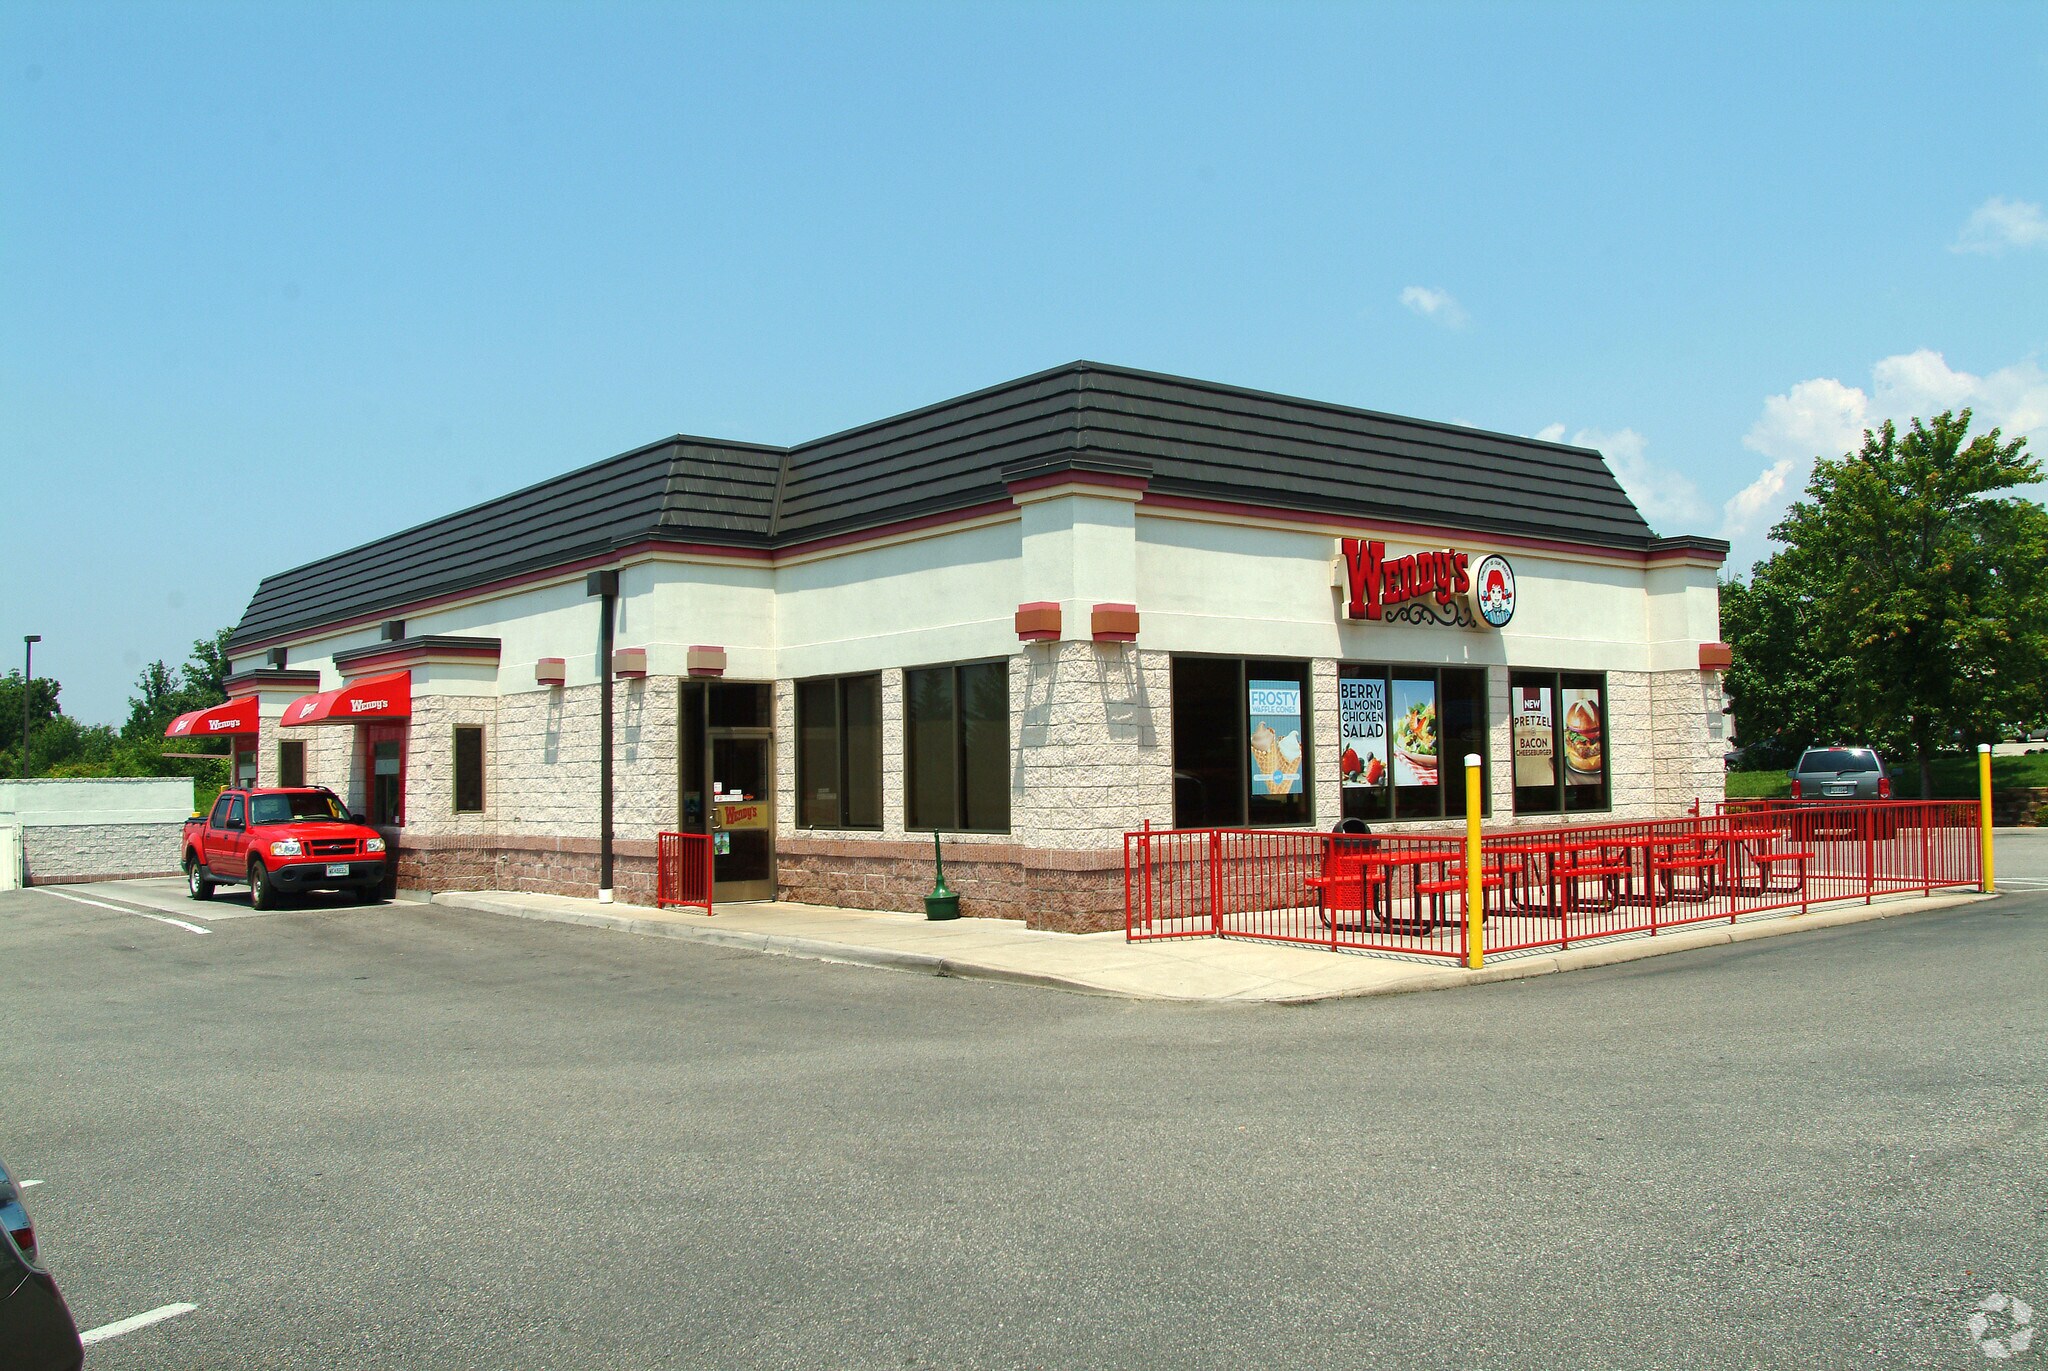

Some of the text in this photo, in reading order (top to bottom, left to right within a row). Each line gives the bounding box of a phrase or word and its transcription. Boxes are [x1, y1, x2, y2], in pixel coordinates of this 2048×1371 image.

[1341, 537, 1470, 620] Wendy's
[1341, 684, 1382, 699] BERRY
[1251, 691, 1298, 706] FROSTY
[1524, 699, 1540, 709] NEW
[1276, 705, 1296, 714] CONES
[1342, 700, 1383, 711] ALMOND
[1342, 711, 1384, 722] CHICKEN
[1514, 715, 1552, 728] PRETZEL
[1343, 724, 1384, 738] SALAD
[1520, 738, 1548, 749] BACON
[1516, 749, 1552, 757] CHEESEBURGER
